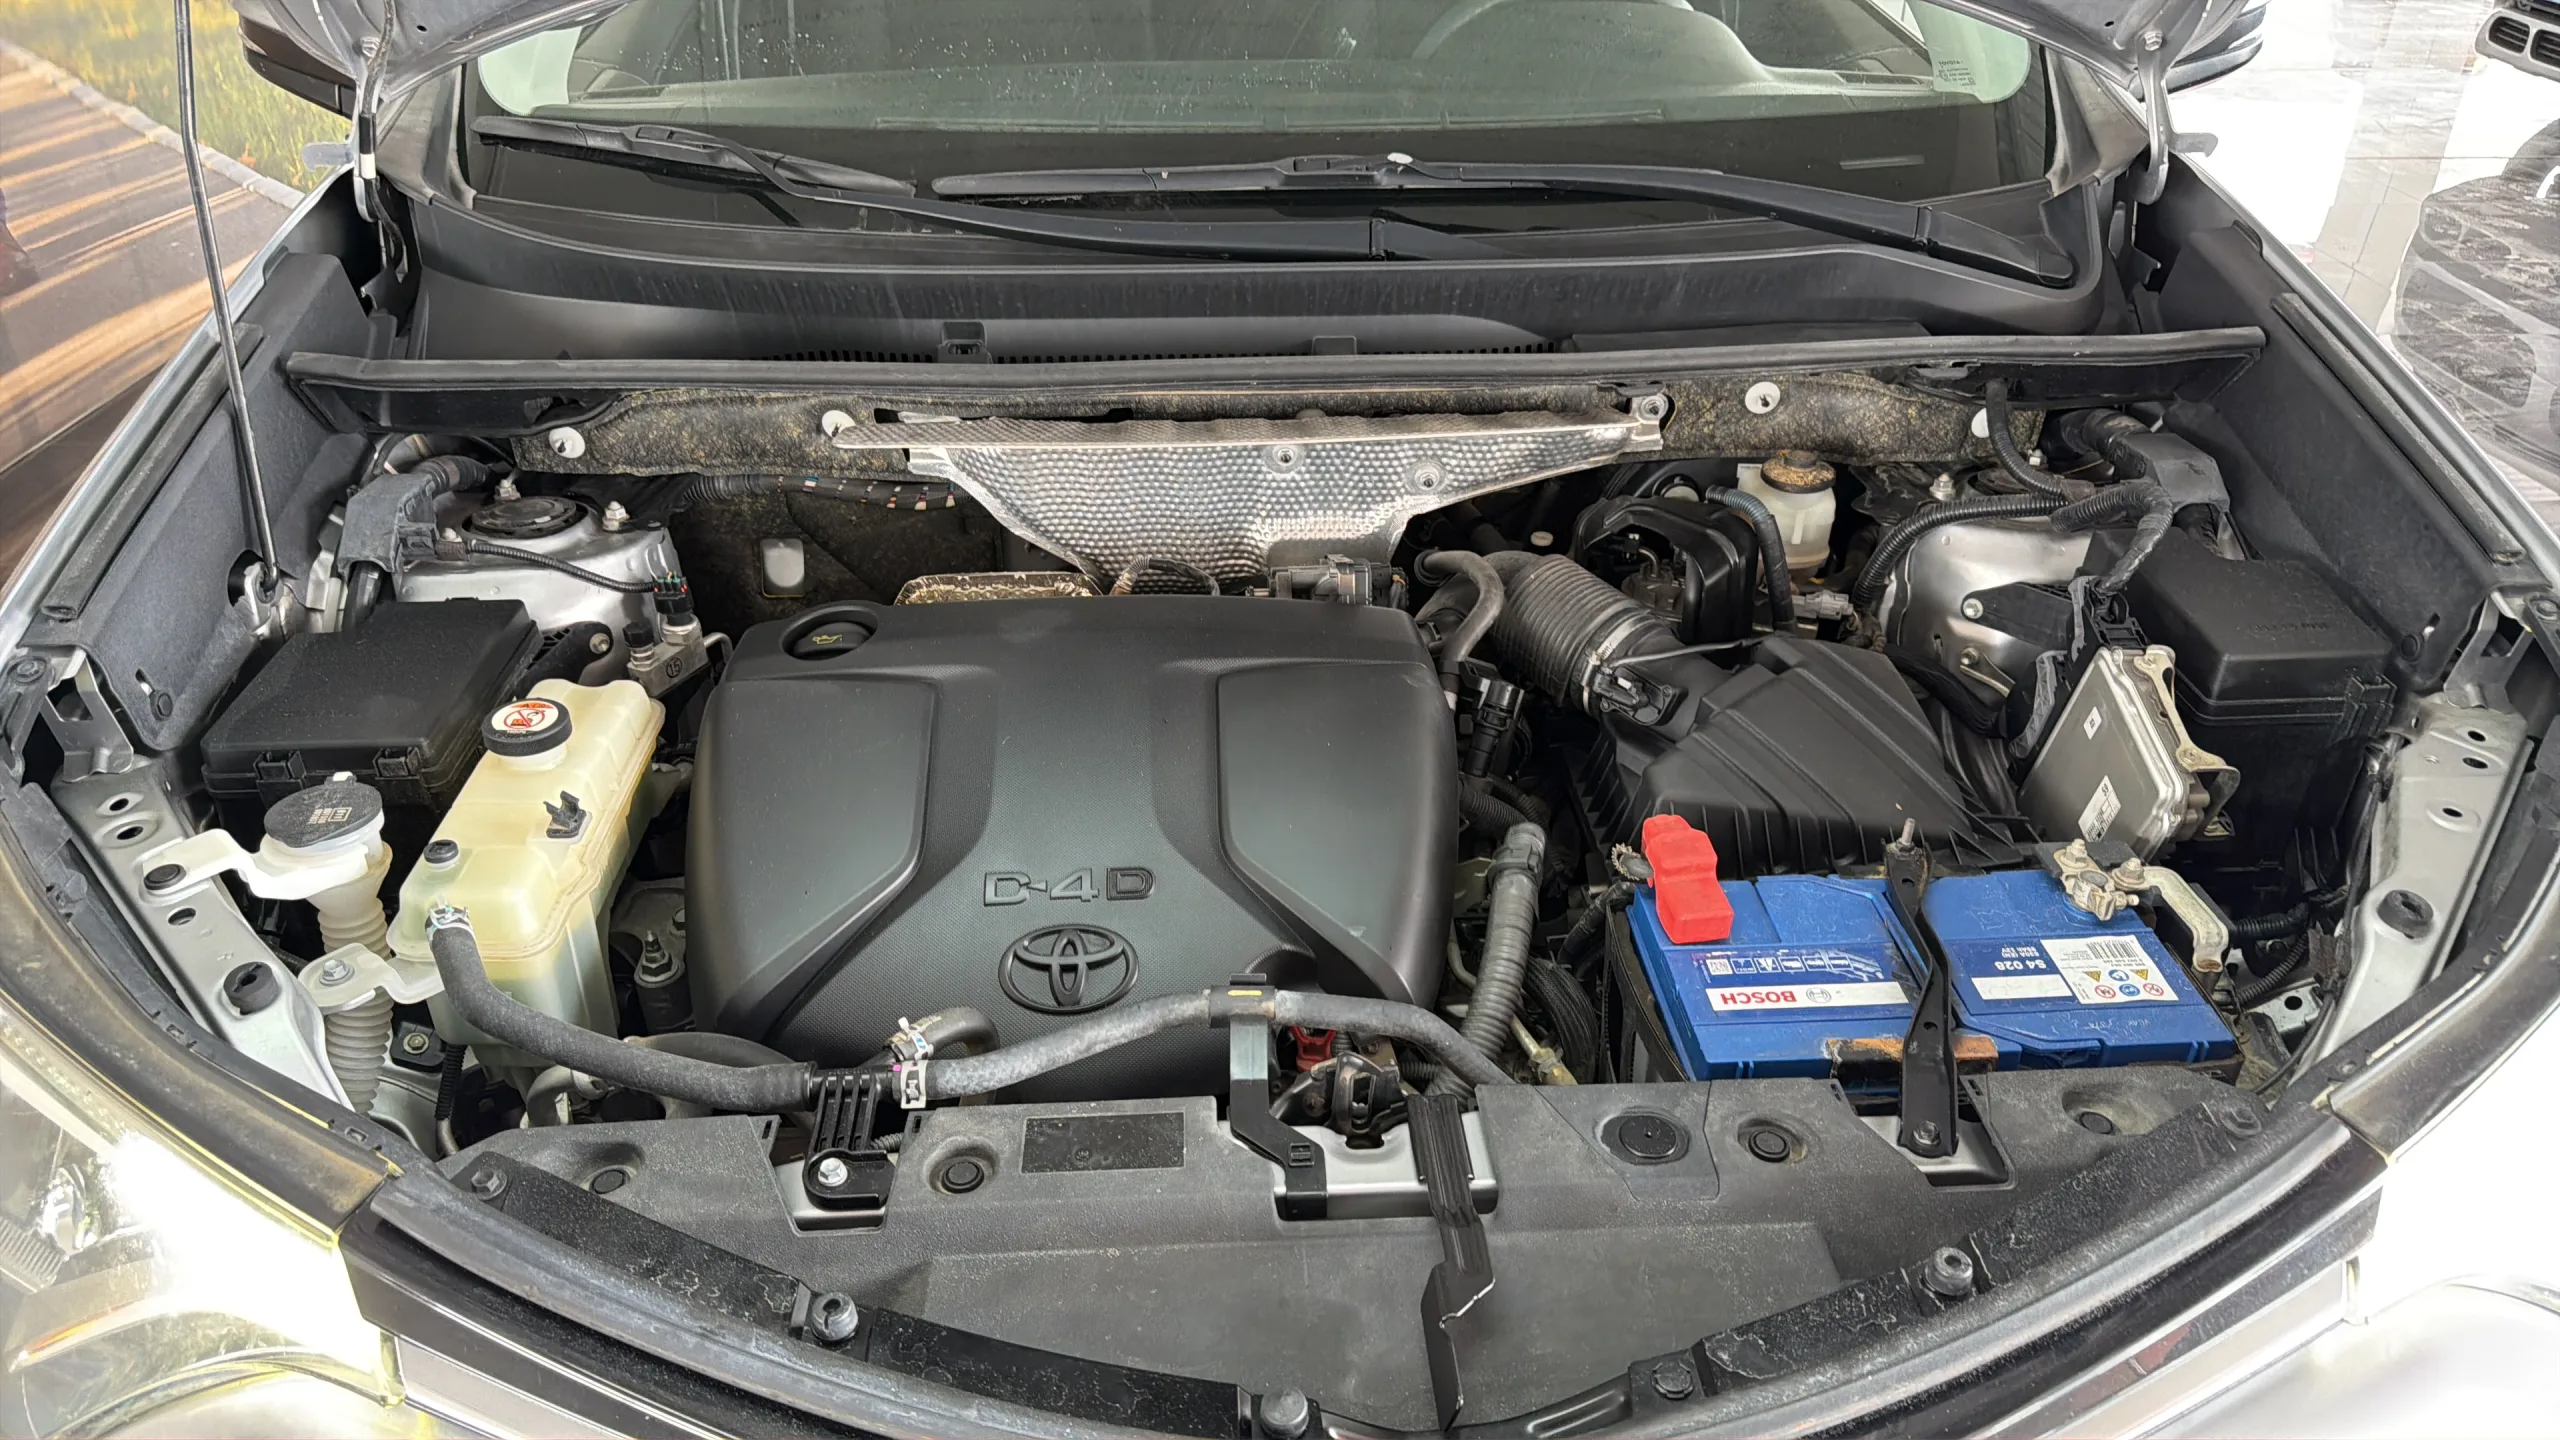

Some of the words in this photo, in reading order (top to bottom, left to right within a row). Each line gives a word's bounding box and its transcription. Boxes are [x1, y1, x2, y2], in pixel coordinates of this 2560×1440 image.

[984, 866, 1156, 907] D-4D
[1994, 960, 2024, 971] 028
[2025, 959, 2047, 969] S4
[1720, 990, 1798, 1004] BOSCH
